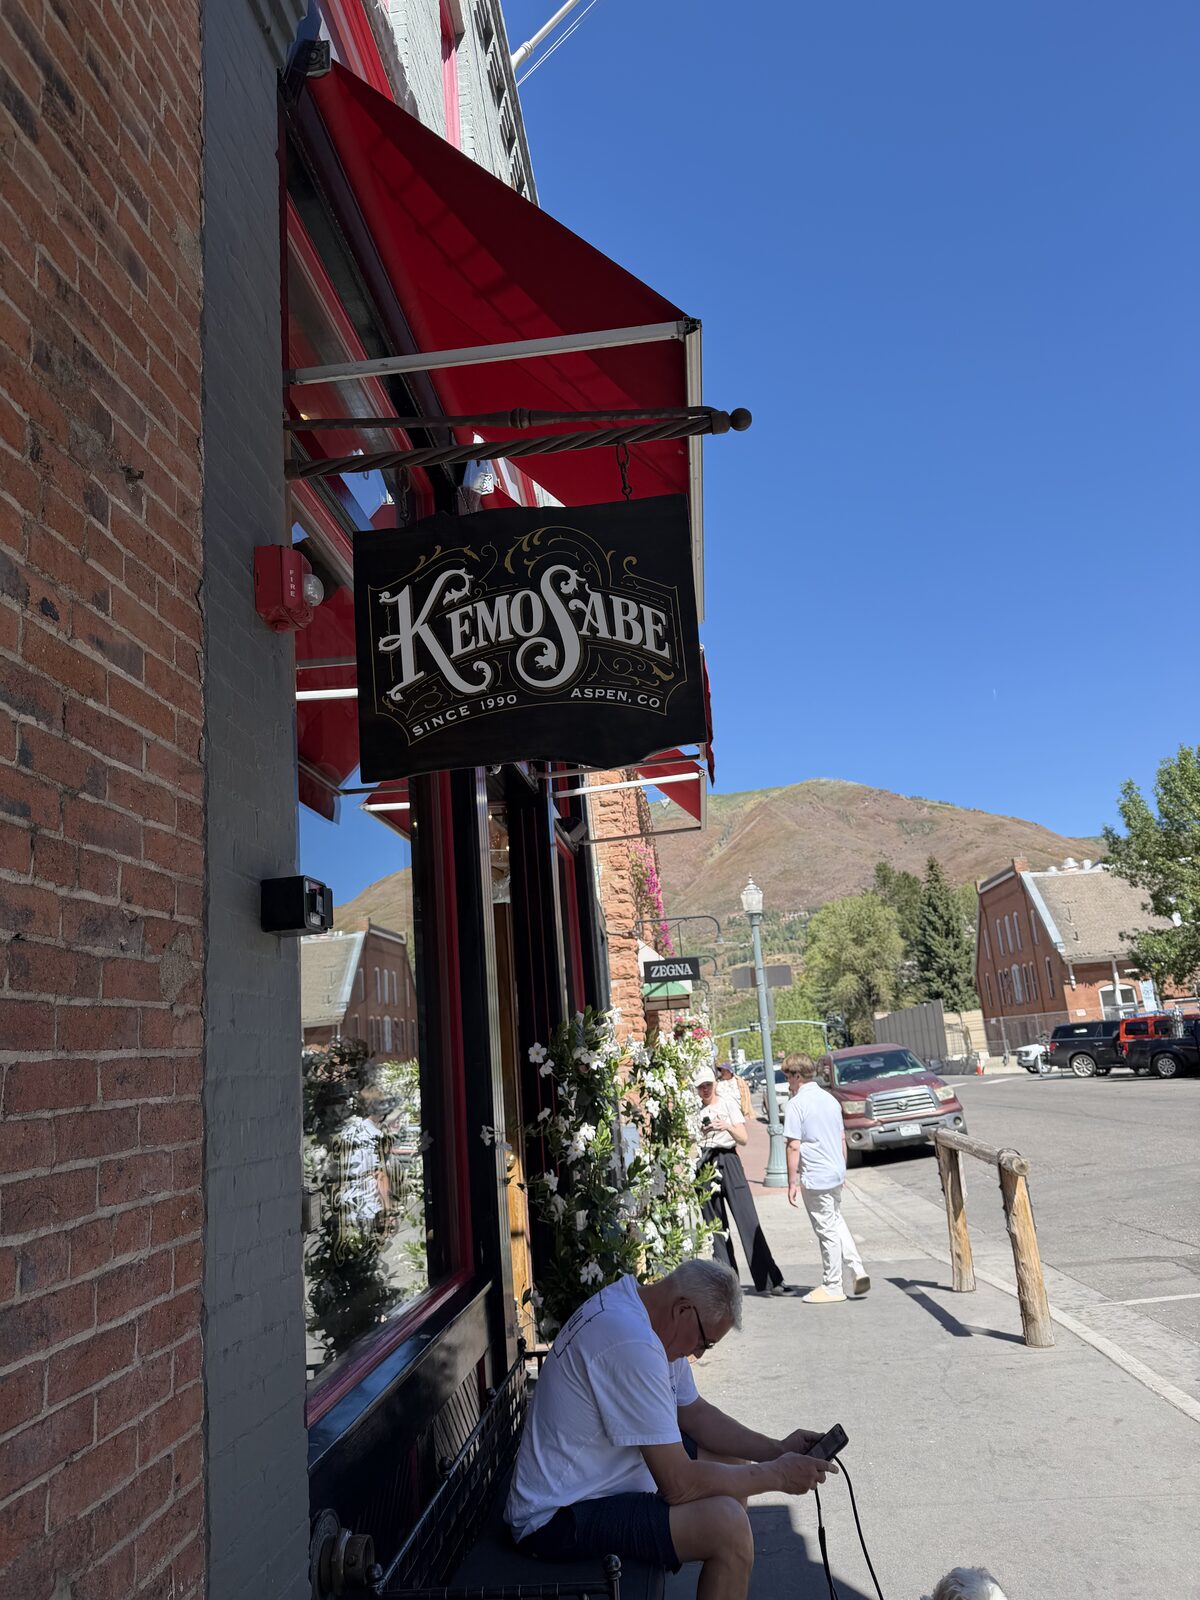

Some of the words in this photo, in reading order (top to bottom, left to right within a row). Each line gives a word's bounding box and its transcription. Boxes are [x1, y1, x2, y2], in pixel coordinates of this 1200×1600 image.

[570, 688, 632, 703] ASPEN,
[637, 694, 660, 708] CO
[412, 705, 471, 736] SINCE
[480, 694, 517, 711] 1990
[650, 963, 694, 978] ZEGNA
